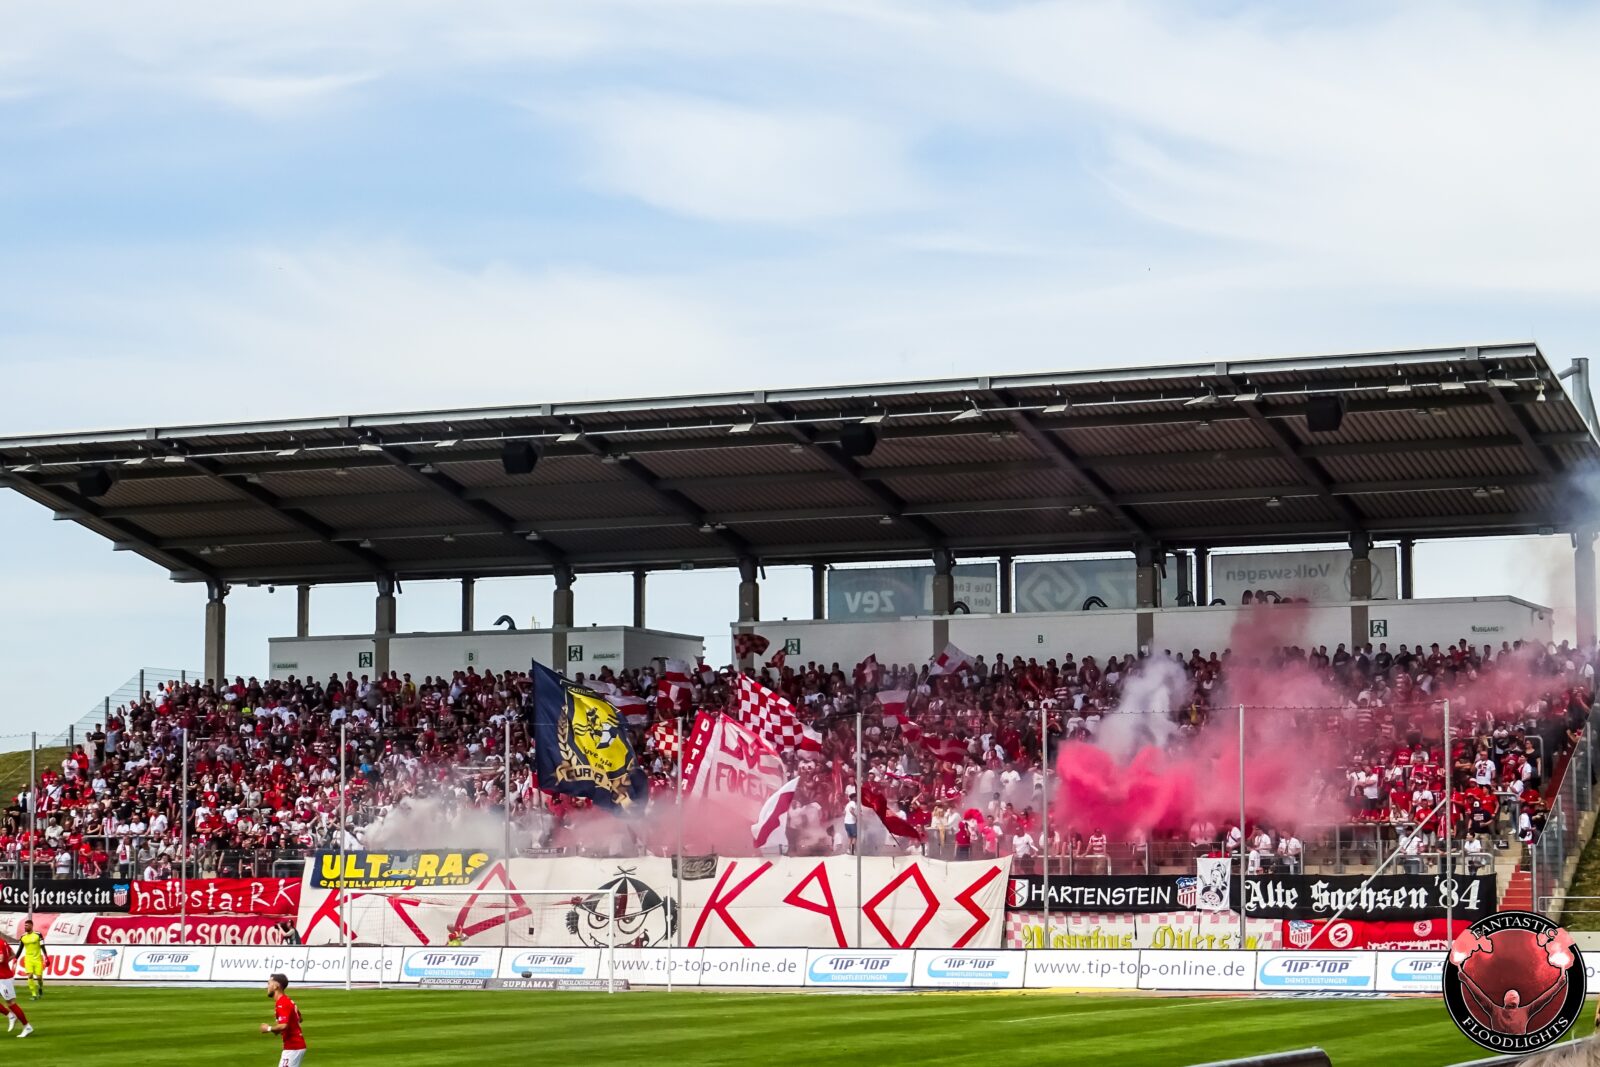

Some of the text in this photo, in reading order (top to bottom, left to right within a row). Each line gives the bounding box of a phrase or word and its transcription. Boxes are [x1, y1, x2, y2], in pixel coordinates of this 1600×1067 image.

[1037, 634, 1044, 644] B
[3, 886, 111, 909] Lichtenstein
[688, 860, 1003, 948] KAOS
[1031, 883, 1171, 906] HARTENSTEIN
[1244, 879, 1299, 912] Alte
[1309, 879, 1429, 913] Sachsen
[220, 955, 393, 973] www.tip-top-onlne.de
[606, 954, 798, 975] www.tip-top-online.de
[1034, 959, 1246, 978] www.tip-top-online.de
[502, 980, 554, 988] SUPRAMAX
